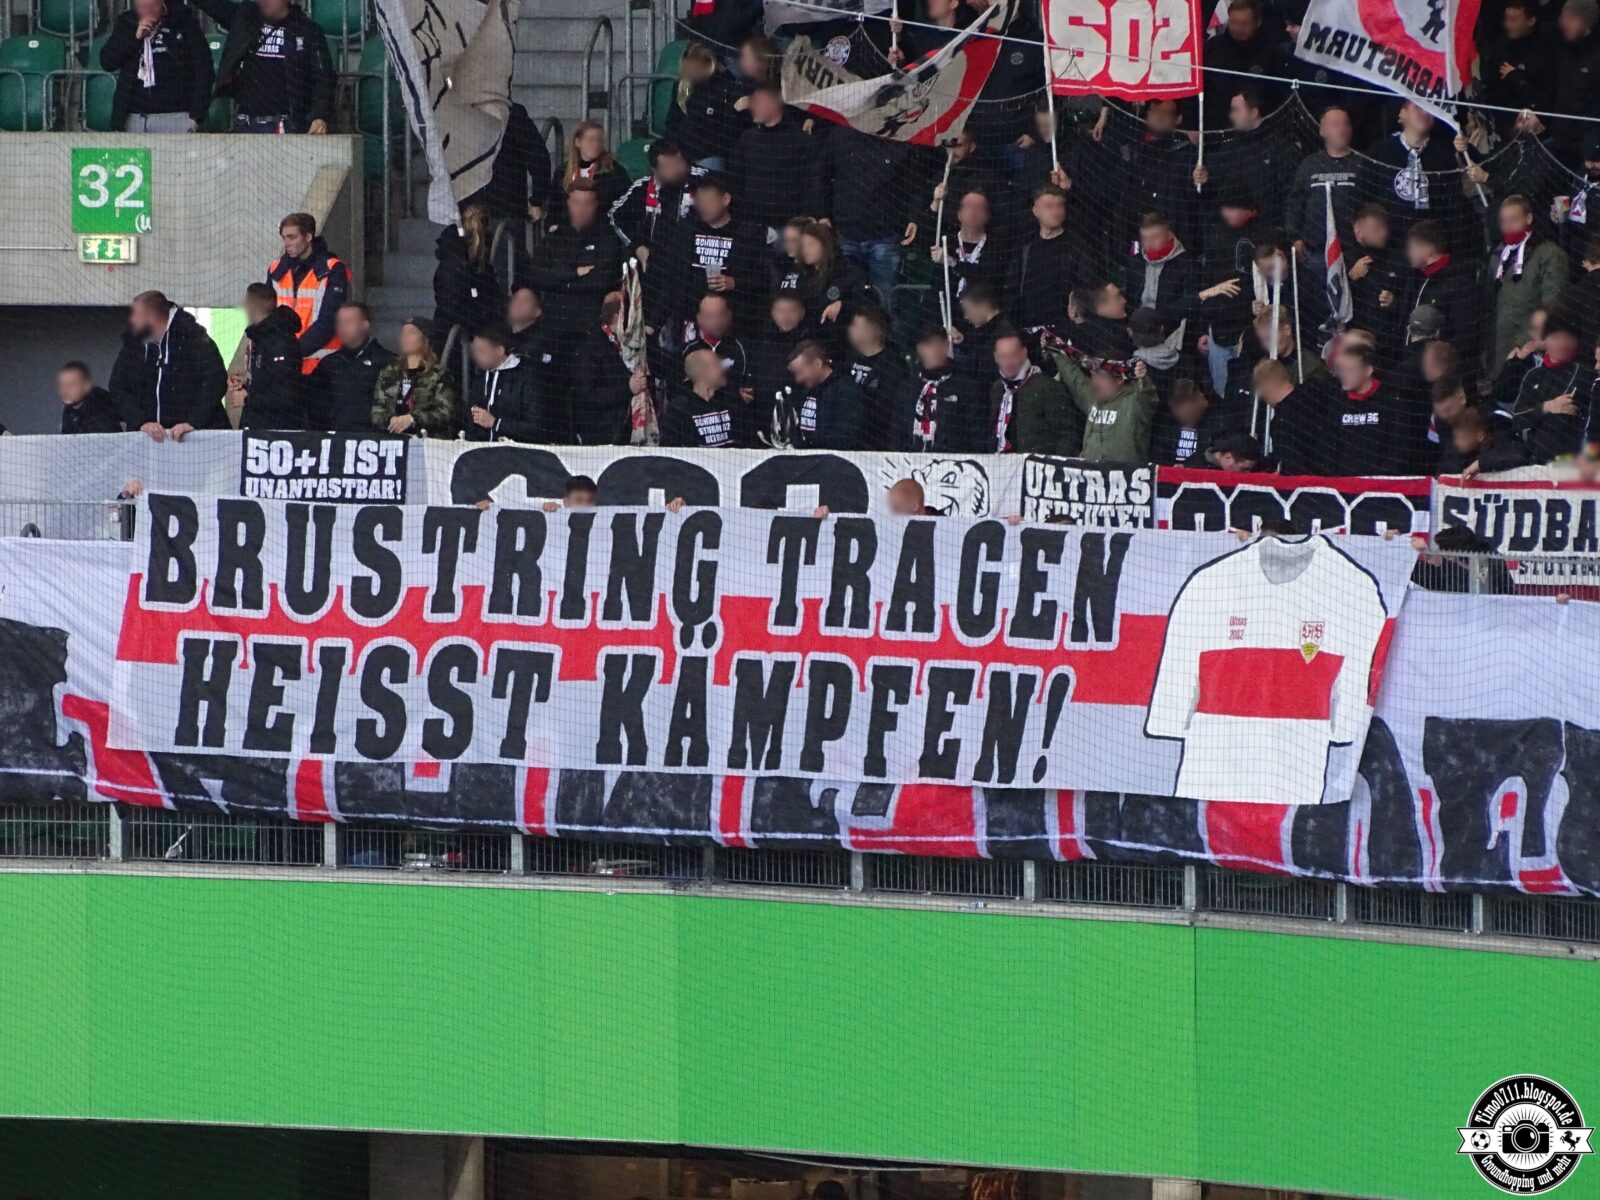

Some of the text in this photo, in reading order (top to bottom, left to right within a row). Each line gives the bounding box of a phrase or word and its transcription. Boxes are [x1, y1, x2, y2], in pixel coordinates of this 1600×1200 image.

[79, 164, 144, 208] 32
[1342, 413, 1367, 424] CREW
[343, 439, 404, 476] IST
[245, 477, 402, 500] UNANTASTBAR!
[1025, 460, 1151, 505] ULTRAS
[145, 492, 1134, 644] BRUSTRING TRAGEN
[174, 623, 1074, 784] HEISST KÄMPFEN!
